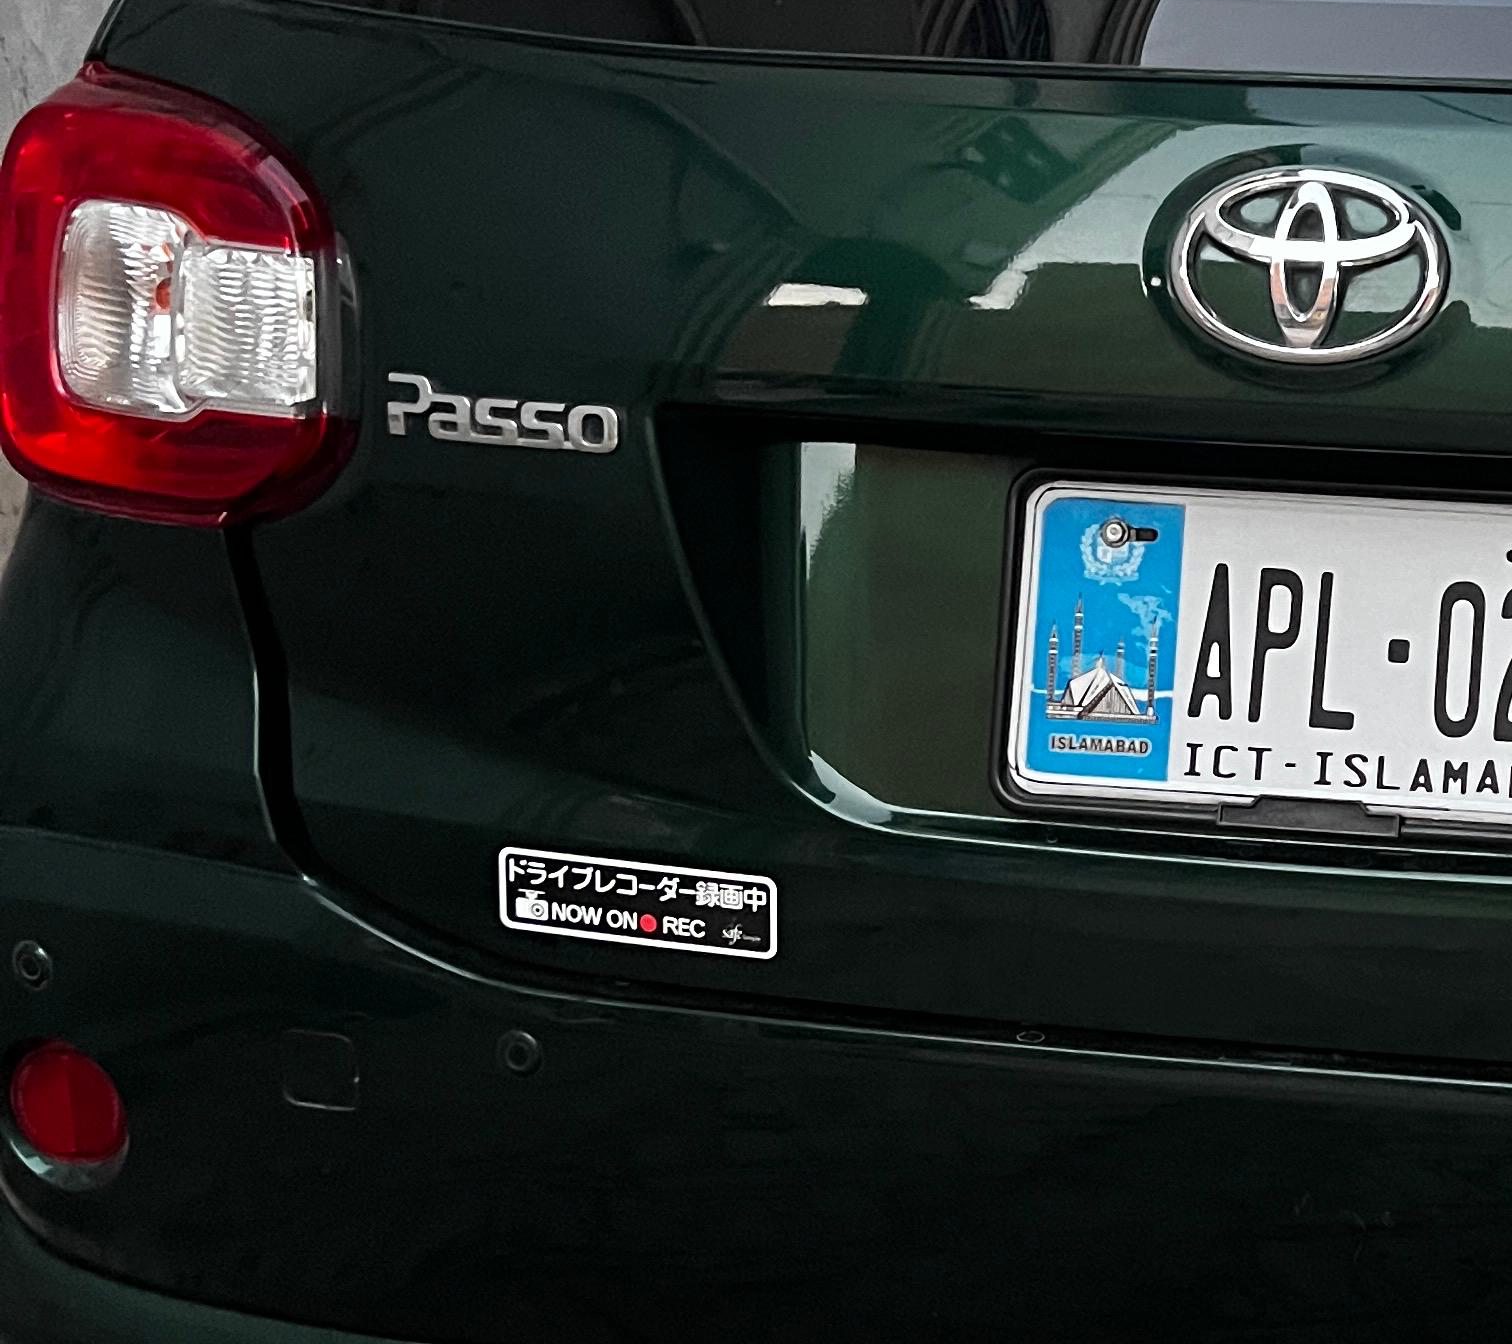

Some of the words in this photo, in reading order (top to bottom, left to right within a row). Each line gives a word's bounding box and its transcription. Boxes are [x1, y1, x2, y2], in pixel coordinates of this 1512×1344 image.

[387, 372, 618, 454] Passo
[1187, 562, 1355, 731] APL
[1050, 733, 1150, 756] ISLAMABAD
[551, 901, 602, 925] NOW
[606, 909, 637, 930] ON
[662, 915, 706, 938] REC
